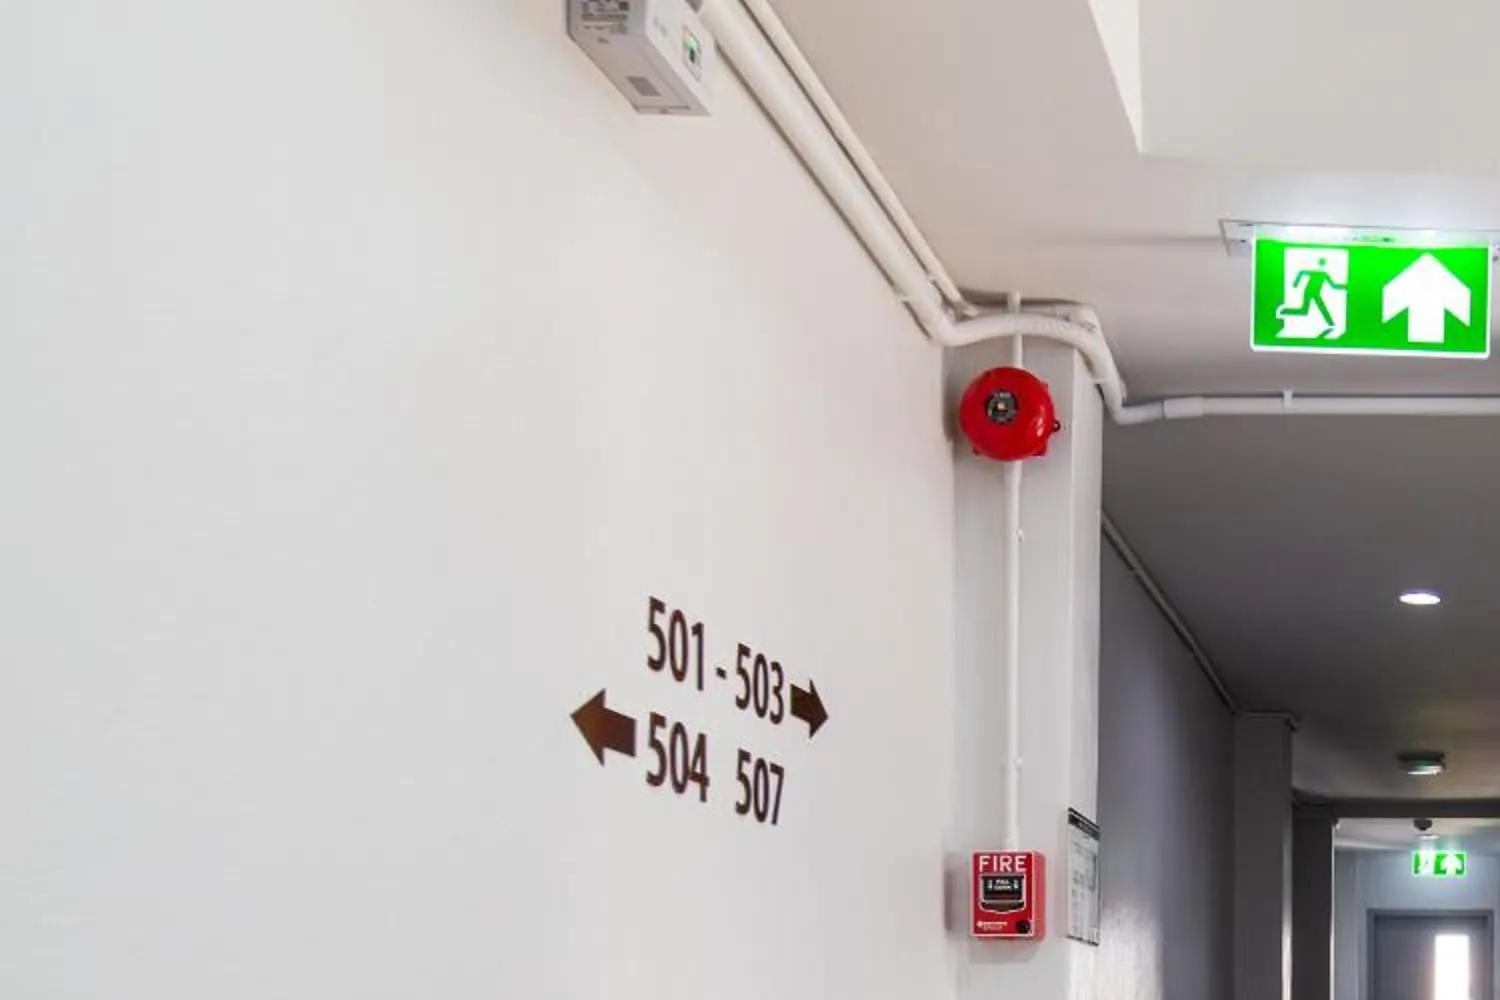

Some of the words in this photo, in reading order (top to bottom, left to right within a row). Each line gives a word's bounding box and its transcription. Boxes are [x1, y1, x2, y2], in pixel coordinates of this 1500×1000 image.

[647, 595, 704, 692] 501
[735, 642, 784, 725] 503
[646, 711, 710, 803] 504
[735, 748, 785, 825] 507
[979, 855, 1027, 872] FIRE
